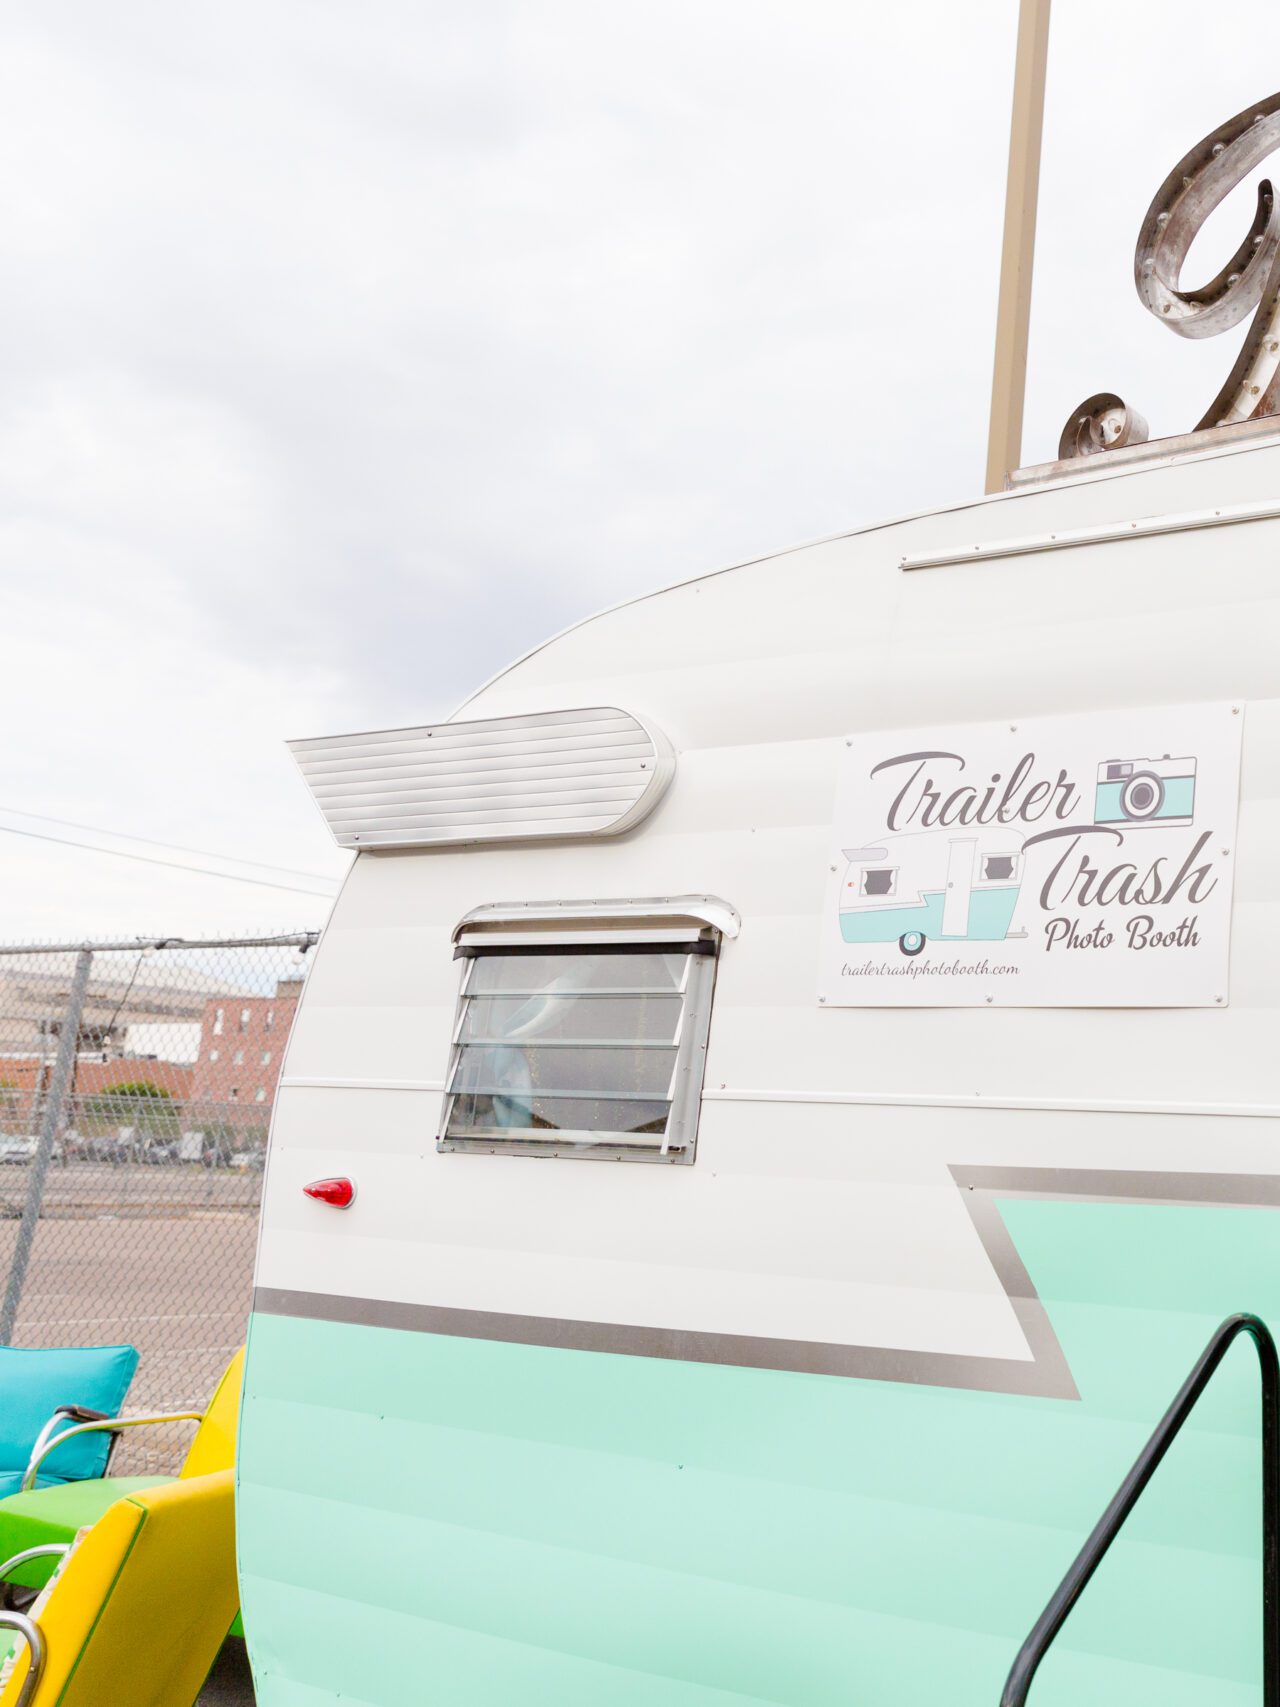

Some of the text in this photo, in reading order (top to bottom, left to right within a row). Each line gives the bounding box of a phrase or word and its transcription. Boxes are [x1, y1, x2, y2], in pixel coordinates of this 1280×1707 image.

[870, 751, 1081, 831] Trailer
[1021, 825, 1218, 910] Trash
[1045, 915, 1201, 952] Photo Booth
[841, 959, 1020, 980] trailertrashphotobooth.com
